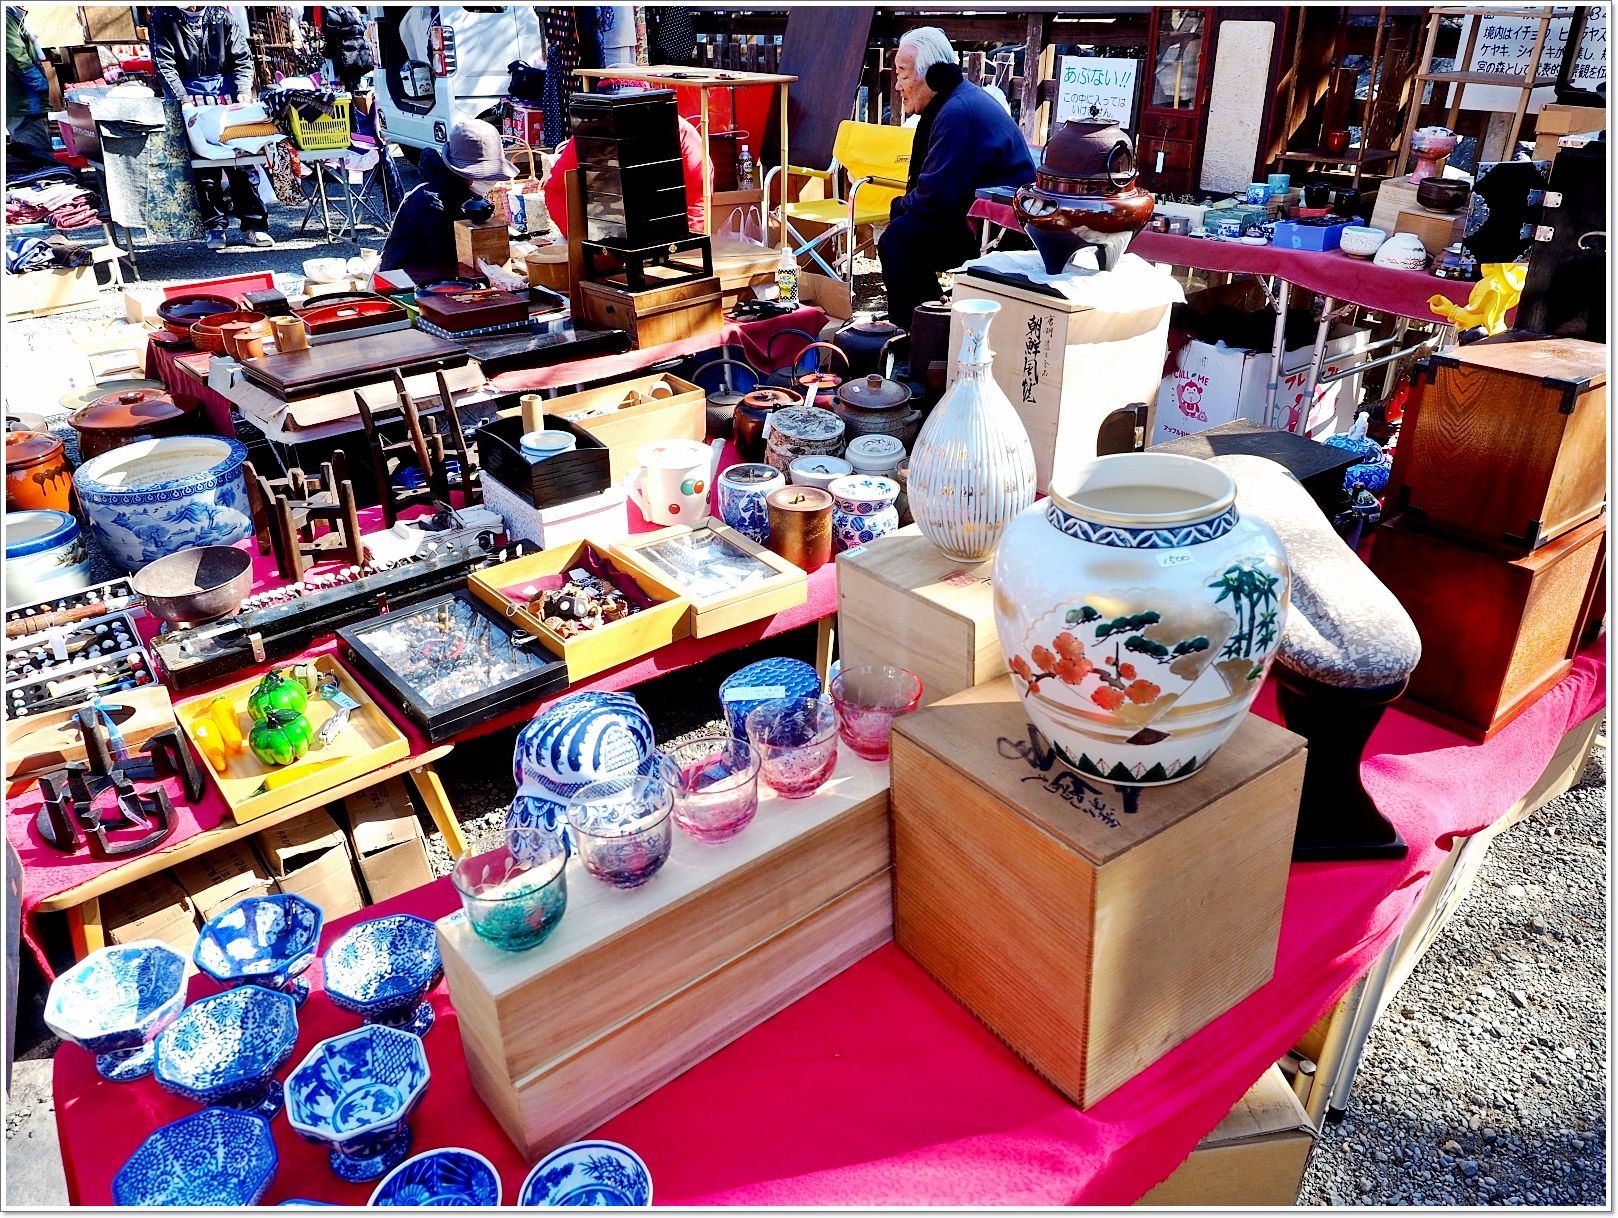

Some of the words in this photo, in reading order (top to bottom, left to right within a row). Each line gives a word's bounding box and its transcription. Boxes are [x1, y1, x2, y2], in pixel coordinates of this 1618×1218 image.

[1063, 93, 1126, 107] この中に入っては
[1174, 370, 1190, 380] CALL
[1197, 374, 1209, 386] ME
